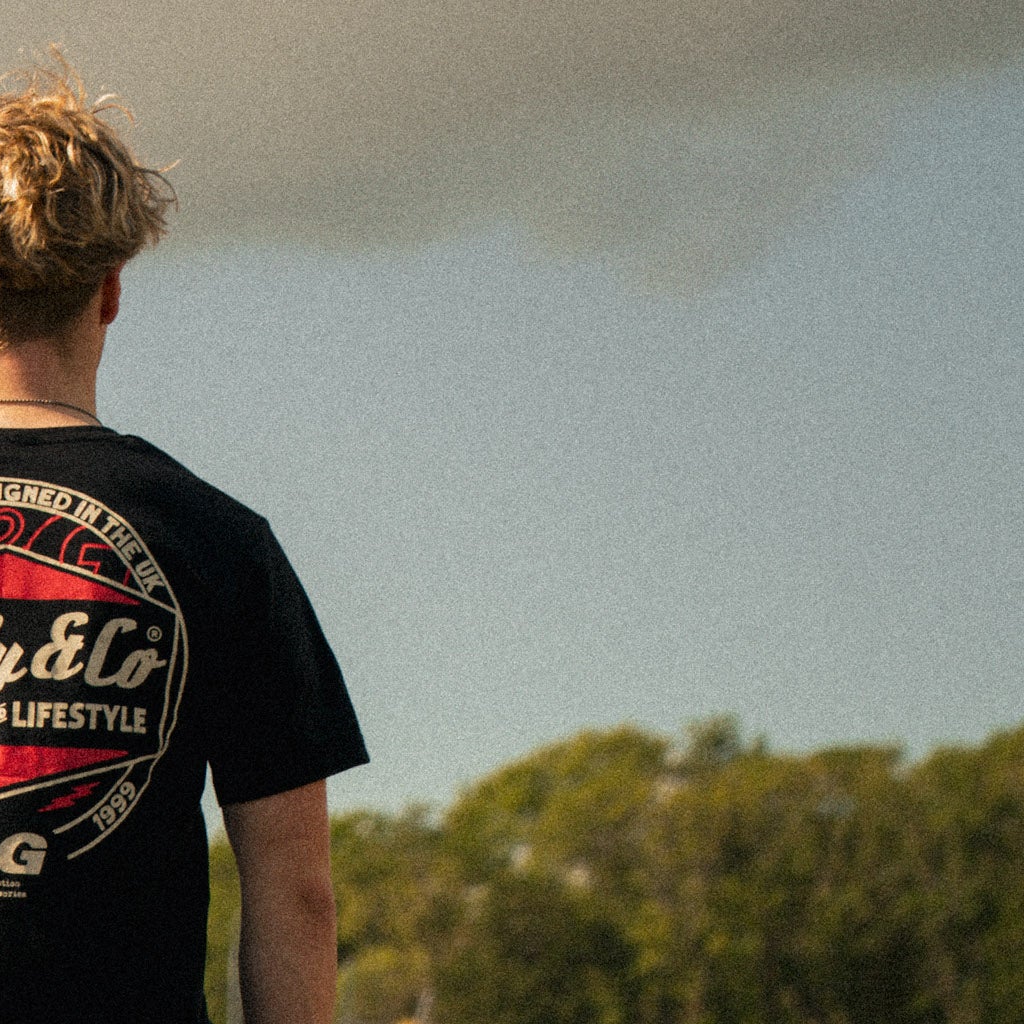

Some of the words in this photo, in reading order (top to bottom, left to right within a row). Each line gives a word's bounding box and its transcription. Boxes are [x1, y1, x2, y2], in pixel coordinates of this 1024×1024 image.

[73, 500, 102, 525] IN
[101, 515, 142, 561] THE
[134, 561, 164, 594] UK
[11, 700, 147, 734] LIFESTYLE
[92, 781, 137, 832] 1999
